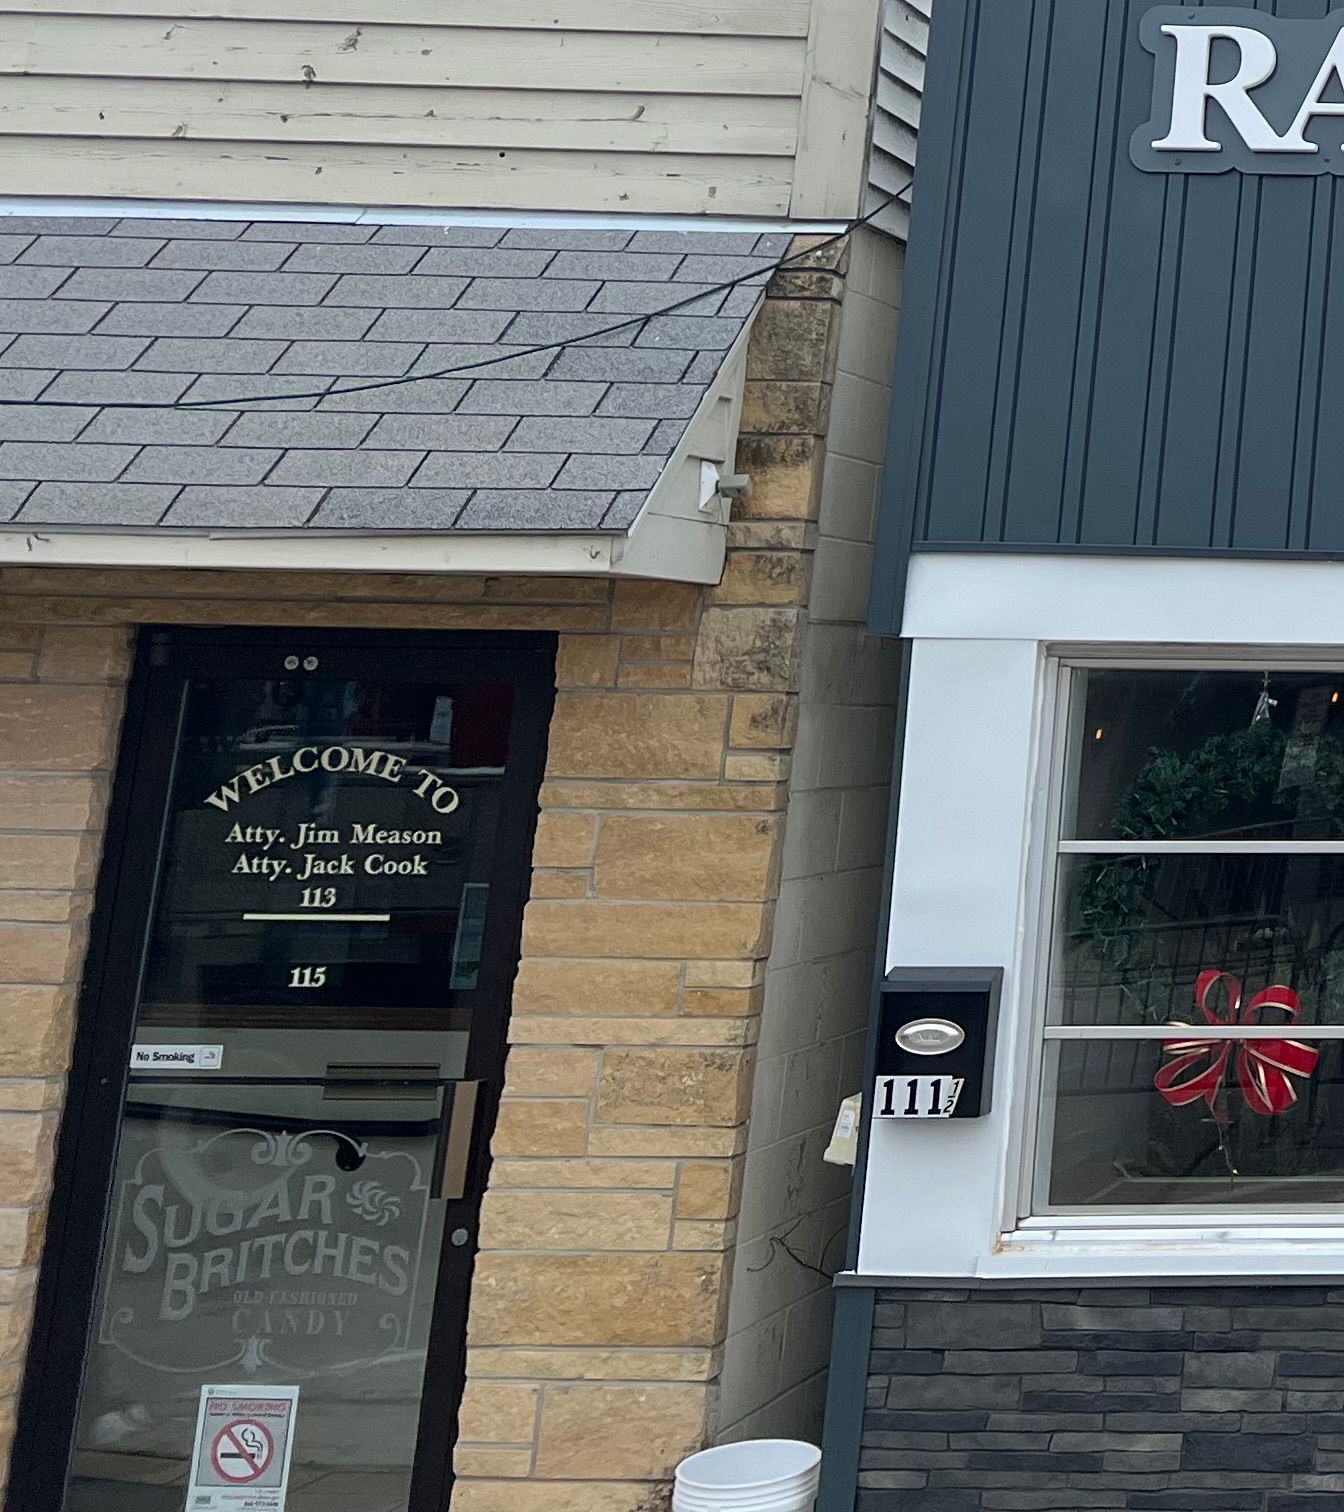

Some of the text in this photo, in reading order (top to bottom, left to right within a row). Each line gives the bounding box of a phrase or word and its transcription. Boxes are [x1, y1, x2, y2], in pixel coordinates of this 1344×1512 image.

[203, 746, 460, 814] WELCOME TO
[225, 822, 442, 850] Atty. Jim Meason
[232, 853, 428, 881] Atty. Jack Cook
[300, 888, 337, 908] 113
[288, 966, 327, 988] 115
[136, 1051, 195, 1064] No Smoking
[880, 1078, 942, 1116] 111
[122, 1175, 337, 1273] SUGAR
[159, 1229, 410, 1321] BRITCHES
[231, 1308, 351, 1336] CANDY
